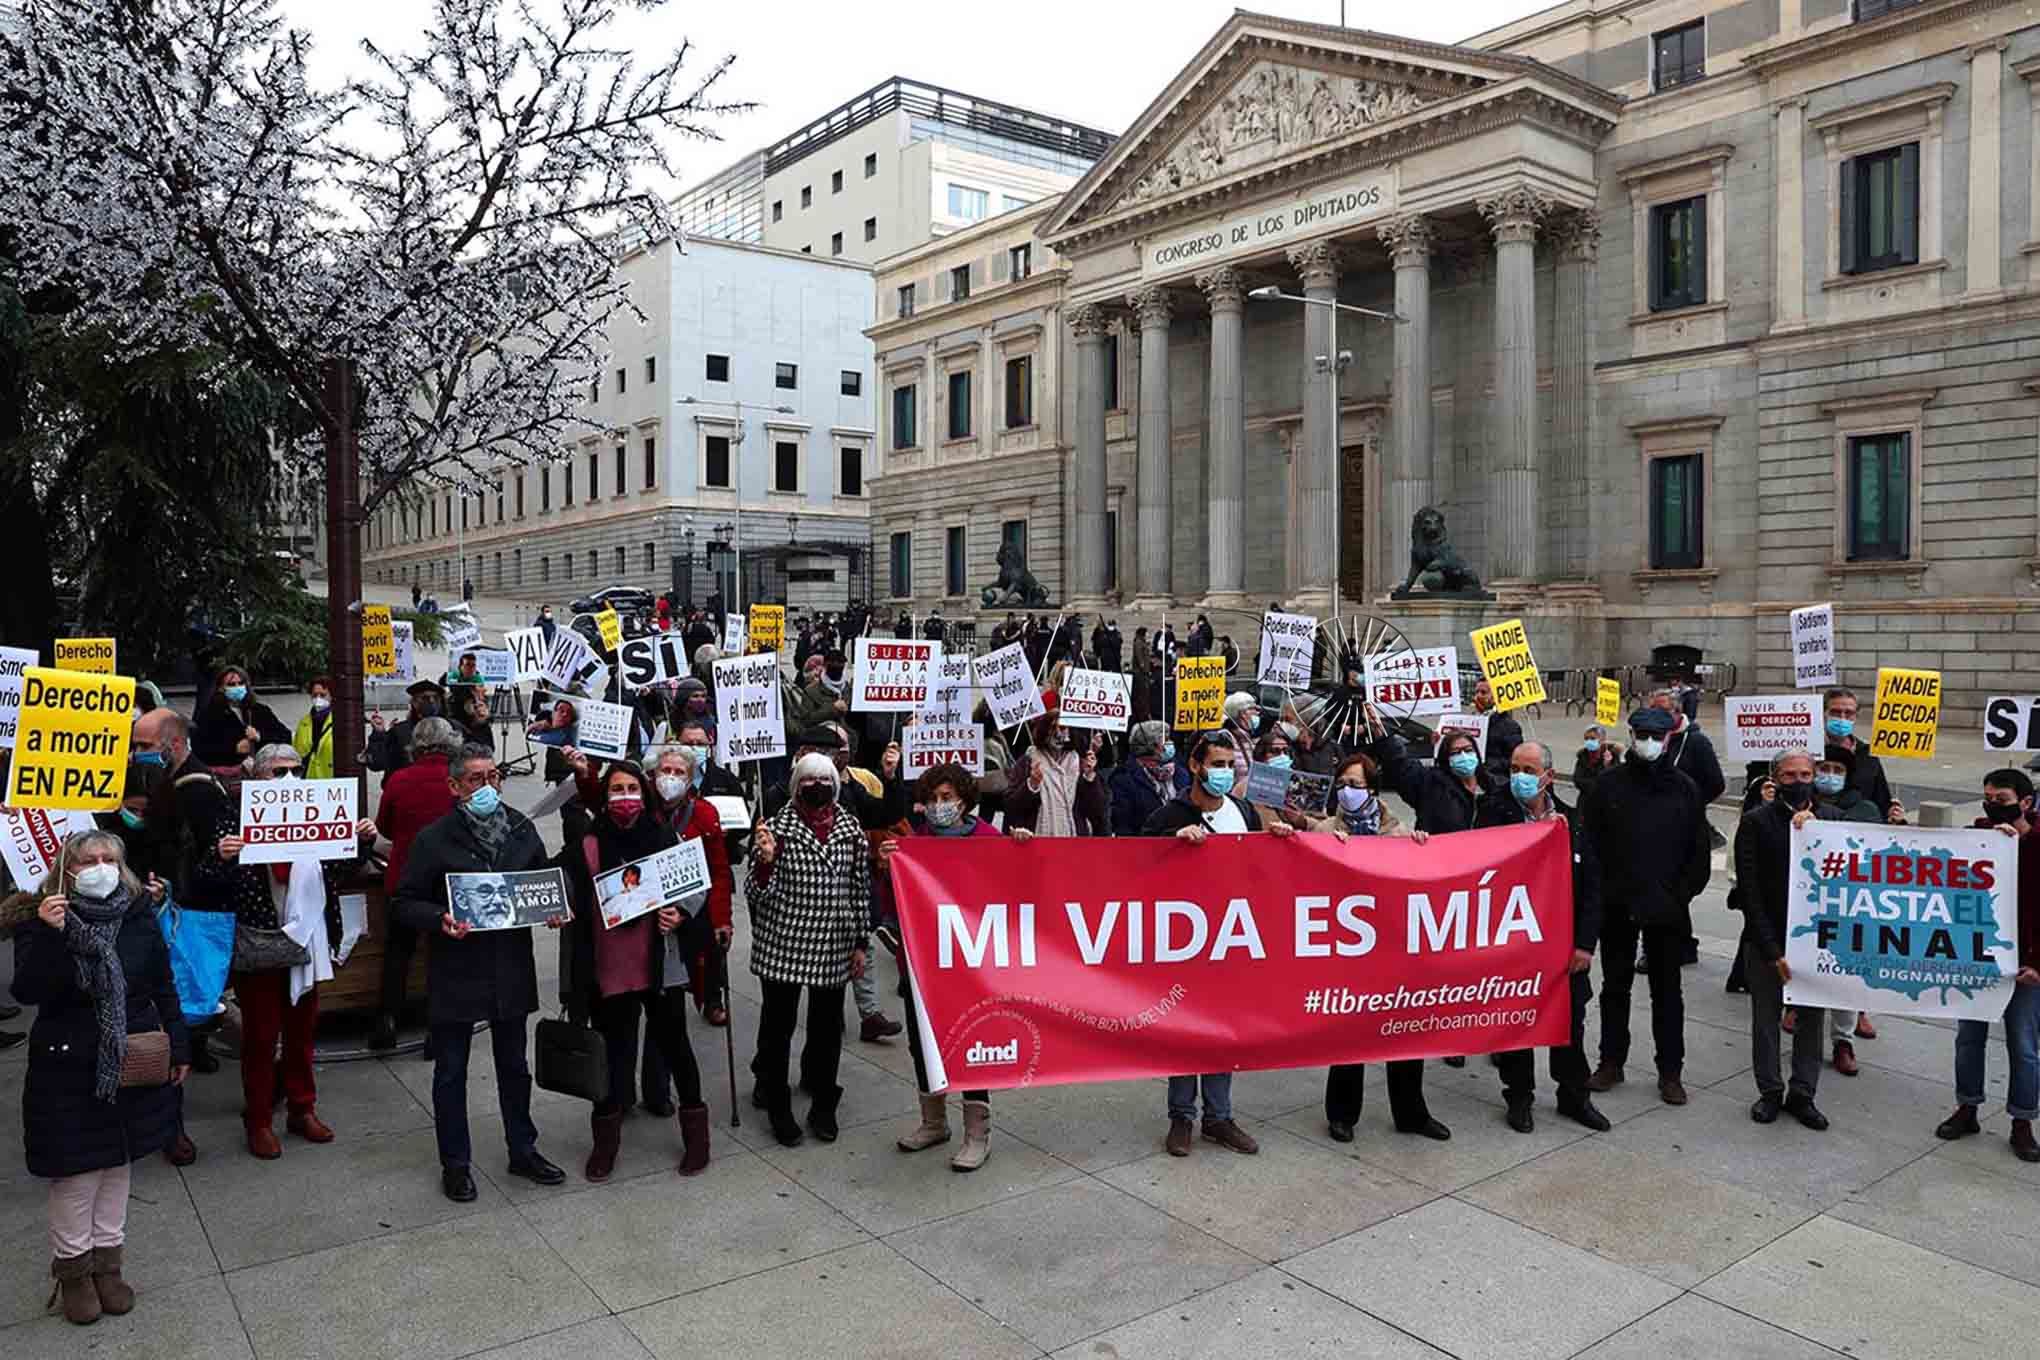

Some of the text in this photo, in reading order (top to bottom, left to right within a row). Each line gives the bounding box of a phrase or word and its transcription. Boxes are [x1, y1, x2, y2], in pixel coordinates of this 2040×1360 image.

[1154, 186, 1380, 265] CONGRESO DE LOS DIPUTADOS
[56, 642, 113, 659] Derecho
[870, 647, 929, 659] BUENA
[1480, 626, 1524, 657] ¡NADIE
[508, 633, 544, 674] YA!
[622, 634, 680, 685] SÍ
[975, 648, 1022, 679] Poder elegir
[1487, 651, 1534, 678] DECIDA
[747, 659, 776, 688] elegir
[869, 660, 927, 672] VIDA
[1178, 664, 1223, 680] Derecho
[868, 673, 927, 685] BUENA
[1883, 675, 1939, 698] ¡NADIE
[24, 678, 130, 713] Derecho
[866, 687, 926, 699] MUERTE
[1067, 687, 1123, 704] VIDA
[1182, 685, 1220, 703] a morir
[1376, 682, 1450, 701] FINAL
[1496, 680, 1525, 704] POR
[729, 696, 767, 722] el morir
[1065, 700, 1122, 716] DECIDO YO
[1178, 709, 1194, 724] EN
[1740, 702, 1807, 712] VIVIR ES
[1878, 702, 1936, 724] DECIDA
[1740, 715, 1808, 725] UN DERECHO
[27, 727, 119, 755] a morir
[1742, 727, 1808, 737] NO UNA
[1874, 728, 1933, 751] POR TÍ!
[729, 733, 744, 757] sin
[911, 750, 975, 766] FINAL
[17, 766, 118, 799] EN PAZ.
[251, 787, 347, 804] SOBRE MI
[250, 804, 347, 823] VIDA
[250, 824, 347, 842] DECIDO YO
[8, 814, 42, 876] DECIDO
[662, 870, 701, 891] NADIE
[1821, 851, 1996, 890] #LIBRES
[513, 881, 557, 893] EUTANASIA
[516, 894, 561, 909] AMOR
[937, 870, 1544, 968] MI VIDA ES MÍA
[1817, 920, 1996, 963] FINAL
[1154, 983, 1188, 1017] VIVIR
[1304, 971, 1543, 1015] #libreshastaelfinal
[1380, 1008, 1537, 1036] derechoamorir.org
[966, 1039, 1018, 1063] dmd
